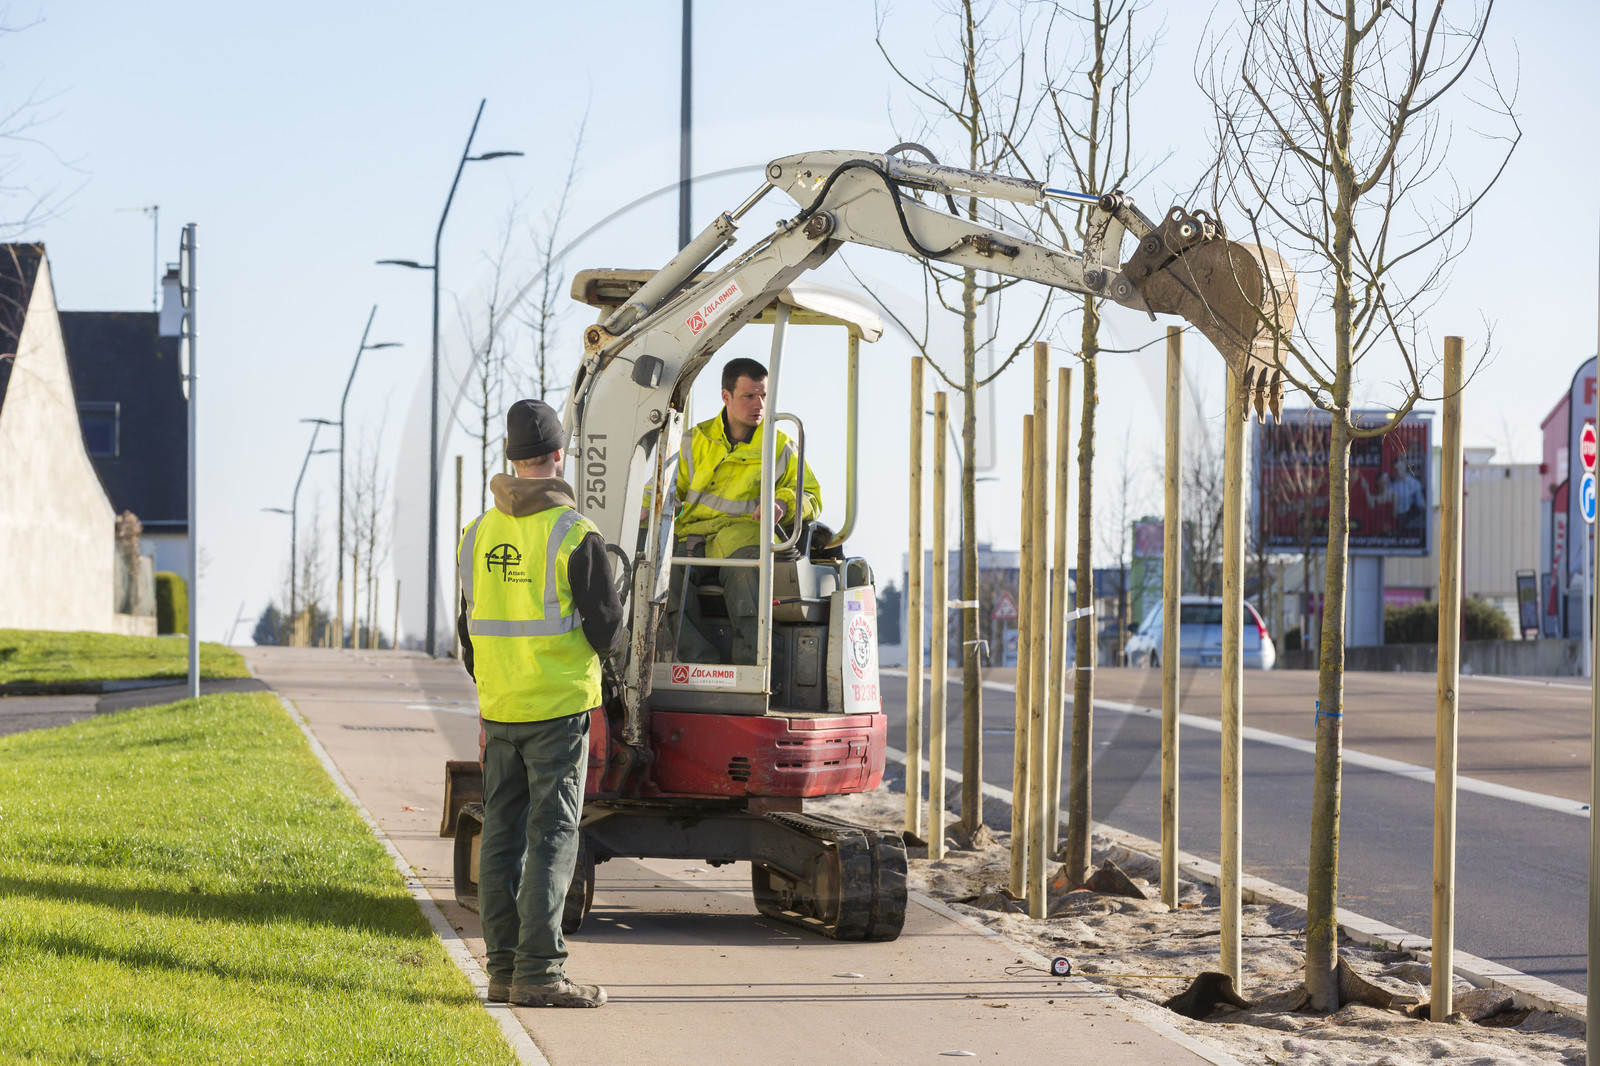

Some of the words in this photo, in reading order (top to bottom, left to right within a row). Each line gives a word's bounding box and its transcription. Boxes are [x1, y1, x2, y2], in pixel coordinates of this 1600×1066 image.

[704, 284, 738, 318] LOCARMOR
[586, 434, 607, 509] 25021
[691, 667, 735, 679] LOCARMOR
